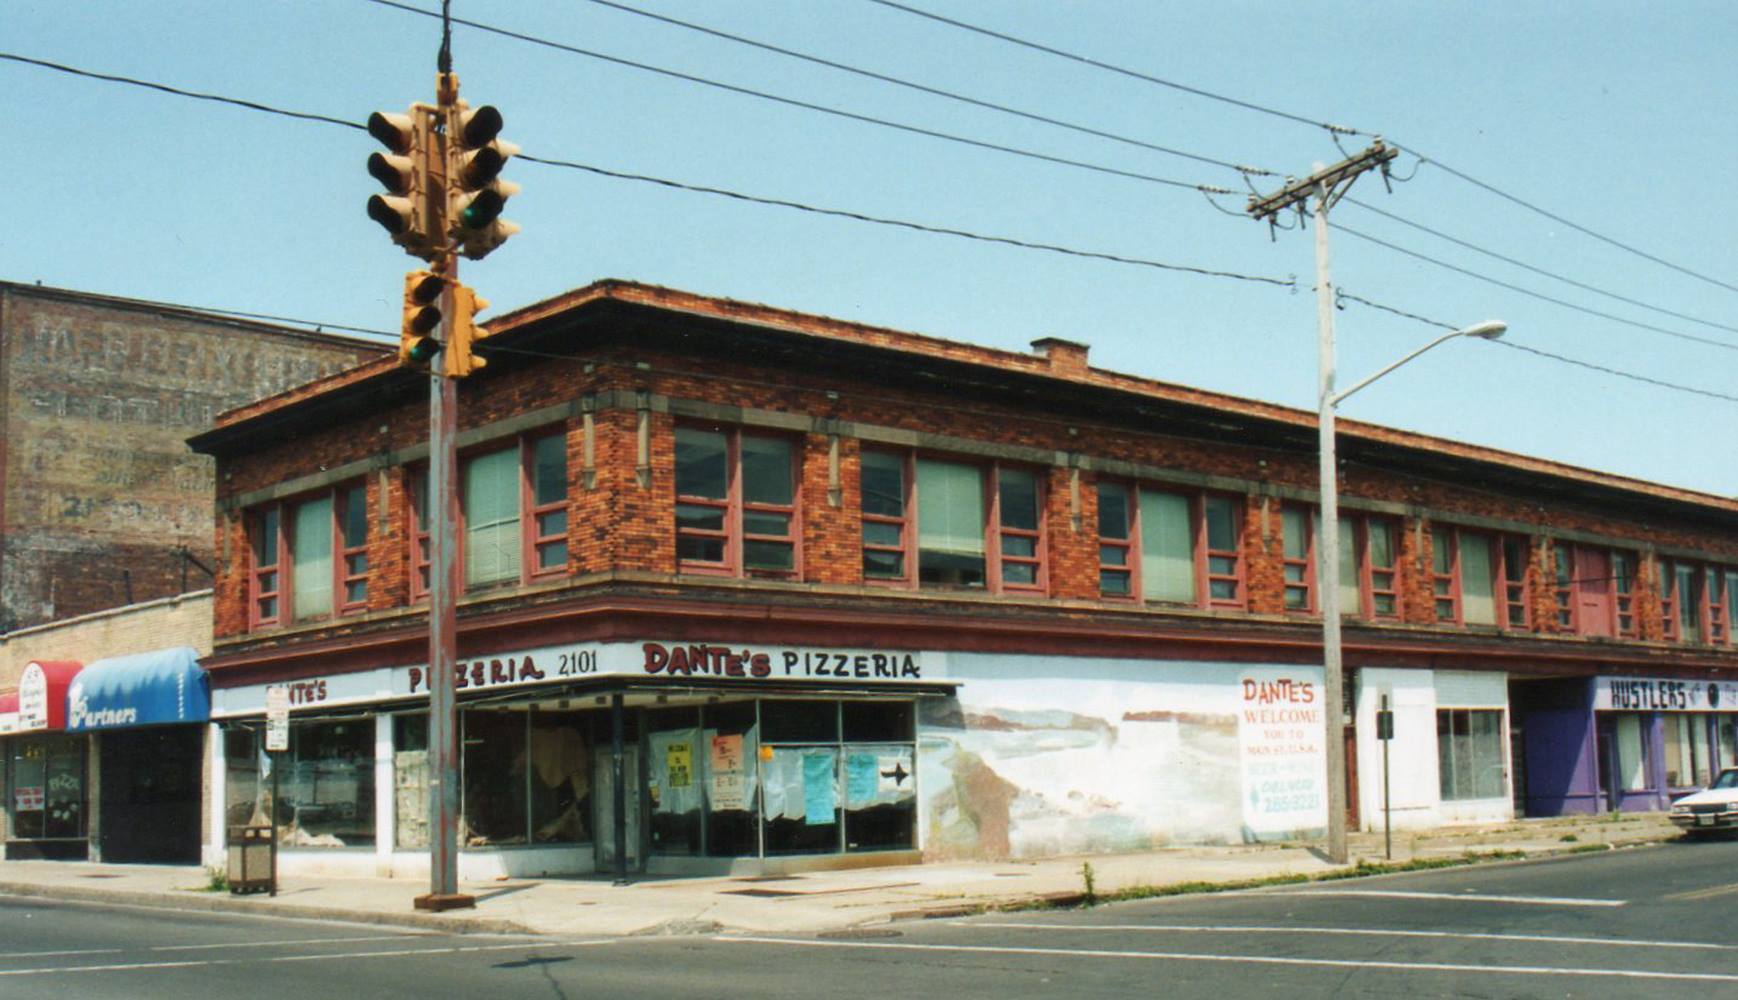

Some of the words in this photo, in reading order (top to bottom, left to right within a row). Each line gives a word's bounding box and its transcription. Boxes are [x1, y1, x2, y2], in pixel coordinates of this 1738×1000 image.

[559, 650, 598, 675] 2101
[782, 651, 921, 678] PIZZERIA
[1242, 678, 1315, 704] DANTE'S
[1610, 680, 1686, 709] HUSTLERS
[1244, 709, 1319, 723] WELCOME
